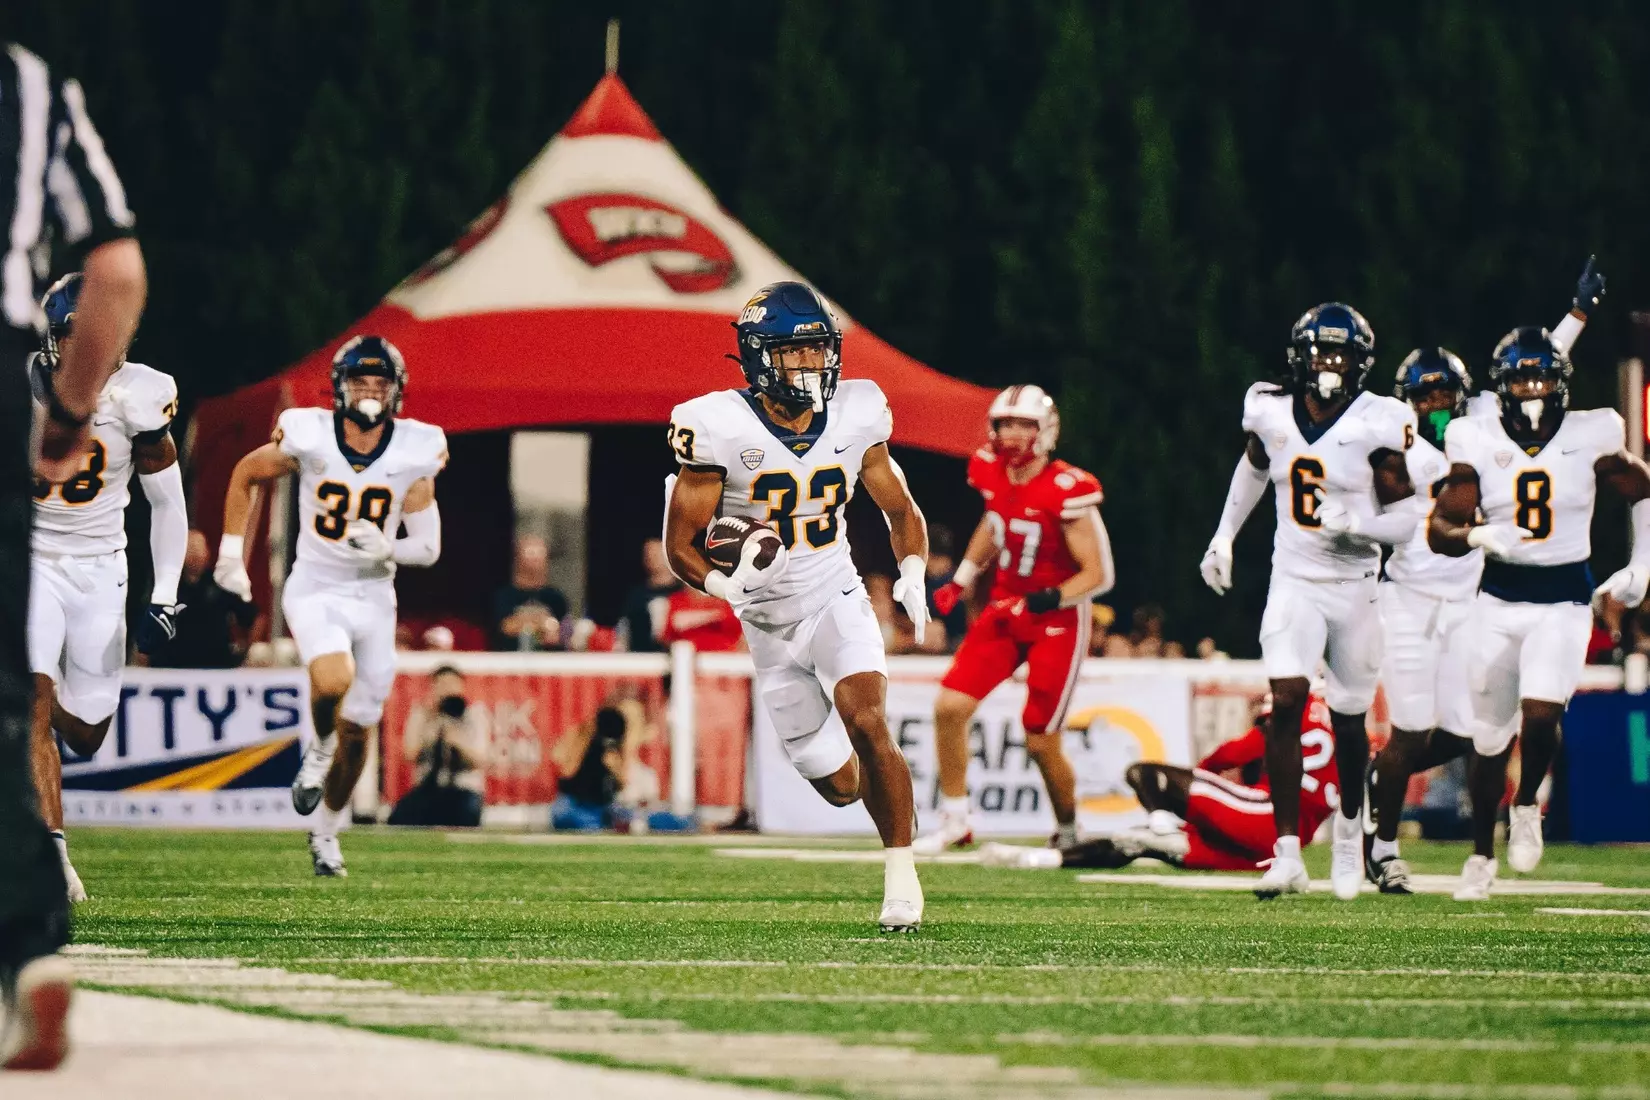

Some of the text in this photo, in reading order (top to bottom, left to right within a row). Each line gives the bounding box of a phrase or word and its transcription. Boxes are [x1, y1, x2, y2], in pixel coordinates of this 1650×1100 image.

[750, 464, 852, 552] 33
[1289, 454, 1327, 531] 6
[1513, 468, 1554, 542] 8
[55, 686, 300, 763] TTY'S
